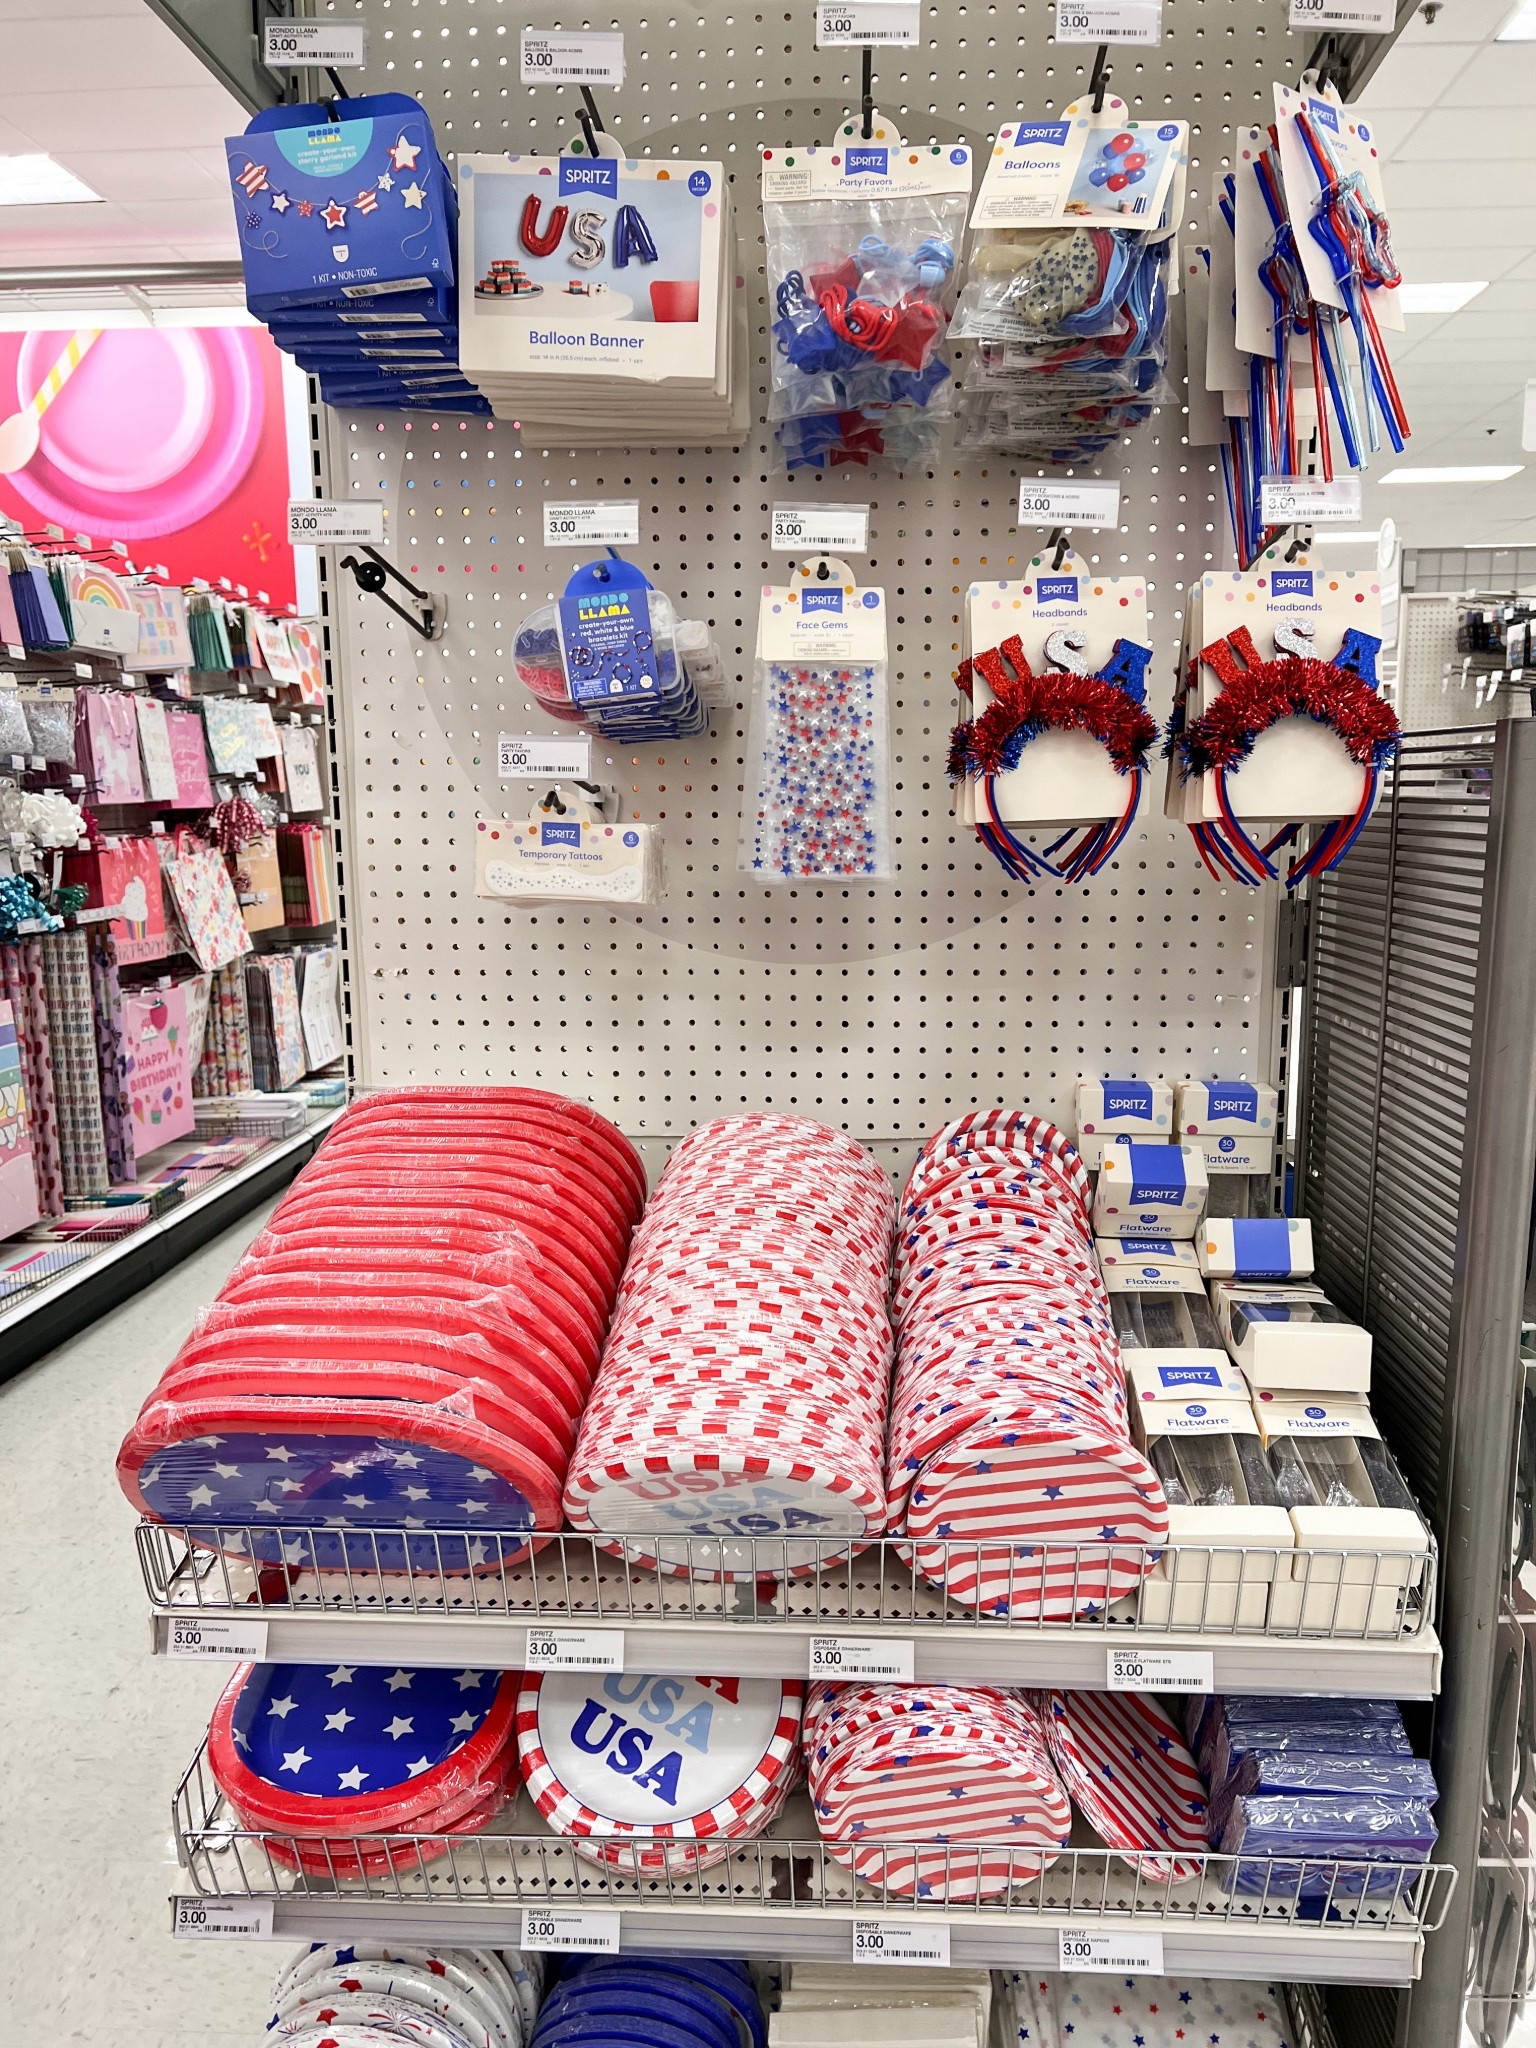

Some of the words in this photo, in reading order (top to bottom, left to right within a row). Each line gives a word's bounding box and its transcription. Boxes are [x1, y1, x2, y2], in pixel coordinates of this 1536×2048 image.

[1295, 0, 1323, 10] 3.00
[823, 20, 852, 32] 3.00
[1060, 15, 1088, 28] 3.00
[269, 39, 297, 50] 3.00
[524, 53, 552, 66] 3.00
[308, 127, 340, 137] MONDO
[1022, 128, 1063, 139] SPRITZ
[308, 134, 341, 145] LLAMA
[850, 156, 884, 168] SPRITZ
[1004, 160, 1061, 170] Balloons
[565, 169, 611, 185] SPRITZ
[693, 176, 706, 186] 14
[840, 178, 862, 188] Party
[864, 178, 893, 186] Favors
[520, 193, 658, 269] USA
[318, 273, 329, 284] KIT
[338, 267, 378, 281] NON-TOXIC
[529, 330, 585, 346] Balloon
[590, 332, 644, 348] Banner
[1023, 498, 1050, 510] 3.00
[291, 518, 317, 529] 3.00
[550, 521, 575, 533] 3.00
[775, 524, 802, 536] 3.00
[1276, 578, 1309, 588] SPRITZ
[1041, 584, 1073, 595] SPRITZ
[578, 592, 629, 609] MONDO
[806, 595, 838, 605] SPRITZ
[579, 604, 630, 621] LLAMA
[1032, 608, 1088, 618] Headbands
[1266, 603, 1322, 612] Headbands
[578, 617, 634, 630] create-your-own
[796, 621, 820, 629] Face
[821, 620, 848, 629] Gems
[588, 634, 619, 644] bracelets
[501, 754, 527, 765] 3.00
[293, 763, 309, 775] YOU
[546, 829, 576, 839] SPRITZ
[518, 850, 567, 860] Temporary
[569, 851, 603, 861] Tattoos
[137, 1050, 168, 1072] HAPPY
[130, 1062, 181, 1093] BIRTHDAY!
[1109, 1099, 1147, 1110] SPRITZ
[1214, 1100, 1252, 1112] SPRITZ
[1136, 1190, 1179, 1199] SPRITZ
[1120, 1224, 1172, 1232] Flatware
[1166, 1371, 1213, 1380] SPRITZ
[1167, 1418, 1229, 1427] Flatware
[1287, 1419, 1350, 1428] Flatware
[618, 1471, 775, 1500] USA
[654, 1486, 804, 1521] USA
[685, 1507, 834, 1537] USA
[174, 1632, 201, 1644] 3.00
[530, 1643, 557, 1656] 3.00
[814, 1651, 842, 1664] 3.00
[1114, 1664, 1143, 1677] 3.00
[603, 1673, 714, 1754] USA
[570, 1698, 683, 1806] USA
[180, 1911, 206, 1924] 3.00
[528, 1922, 554, 1936] 3.00
[857, 1935, 883, 1948] 3.00
[1063, 1943, 1091, 1956] 3.00
